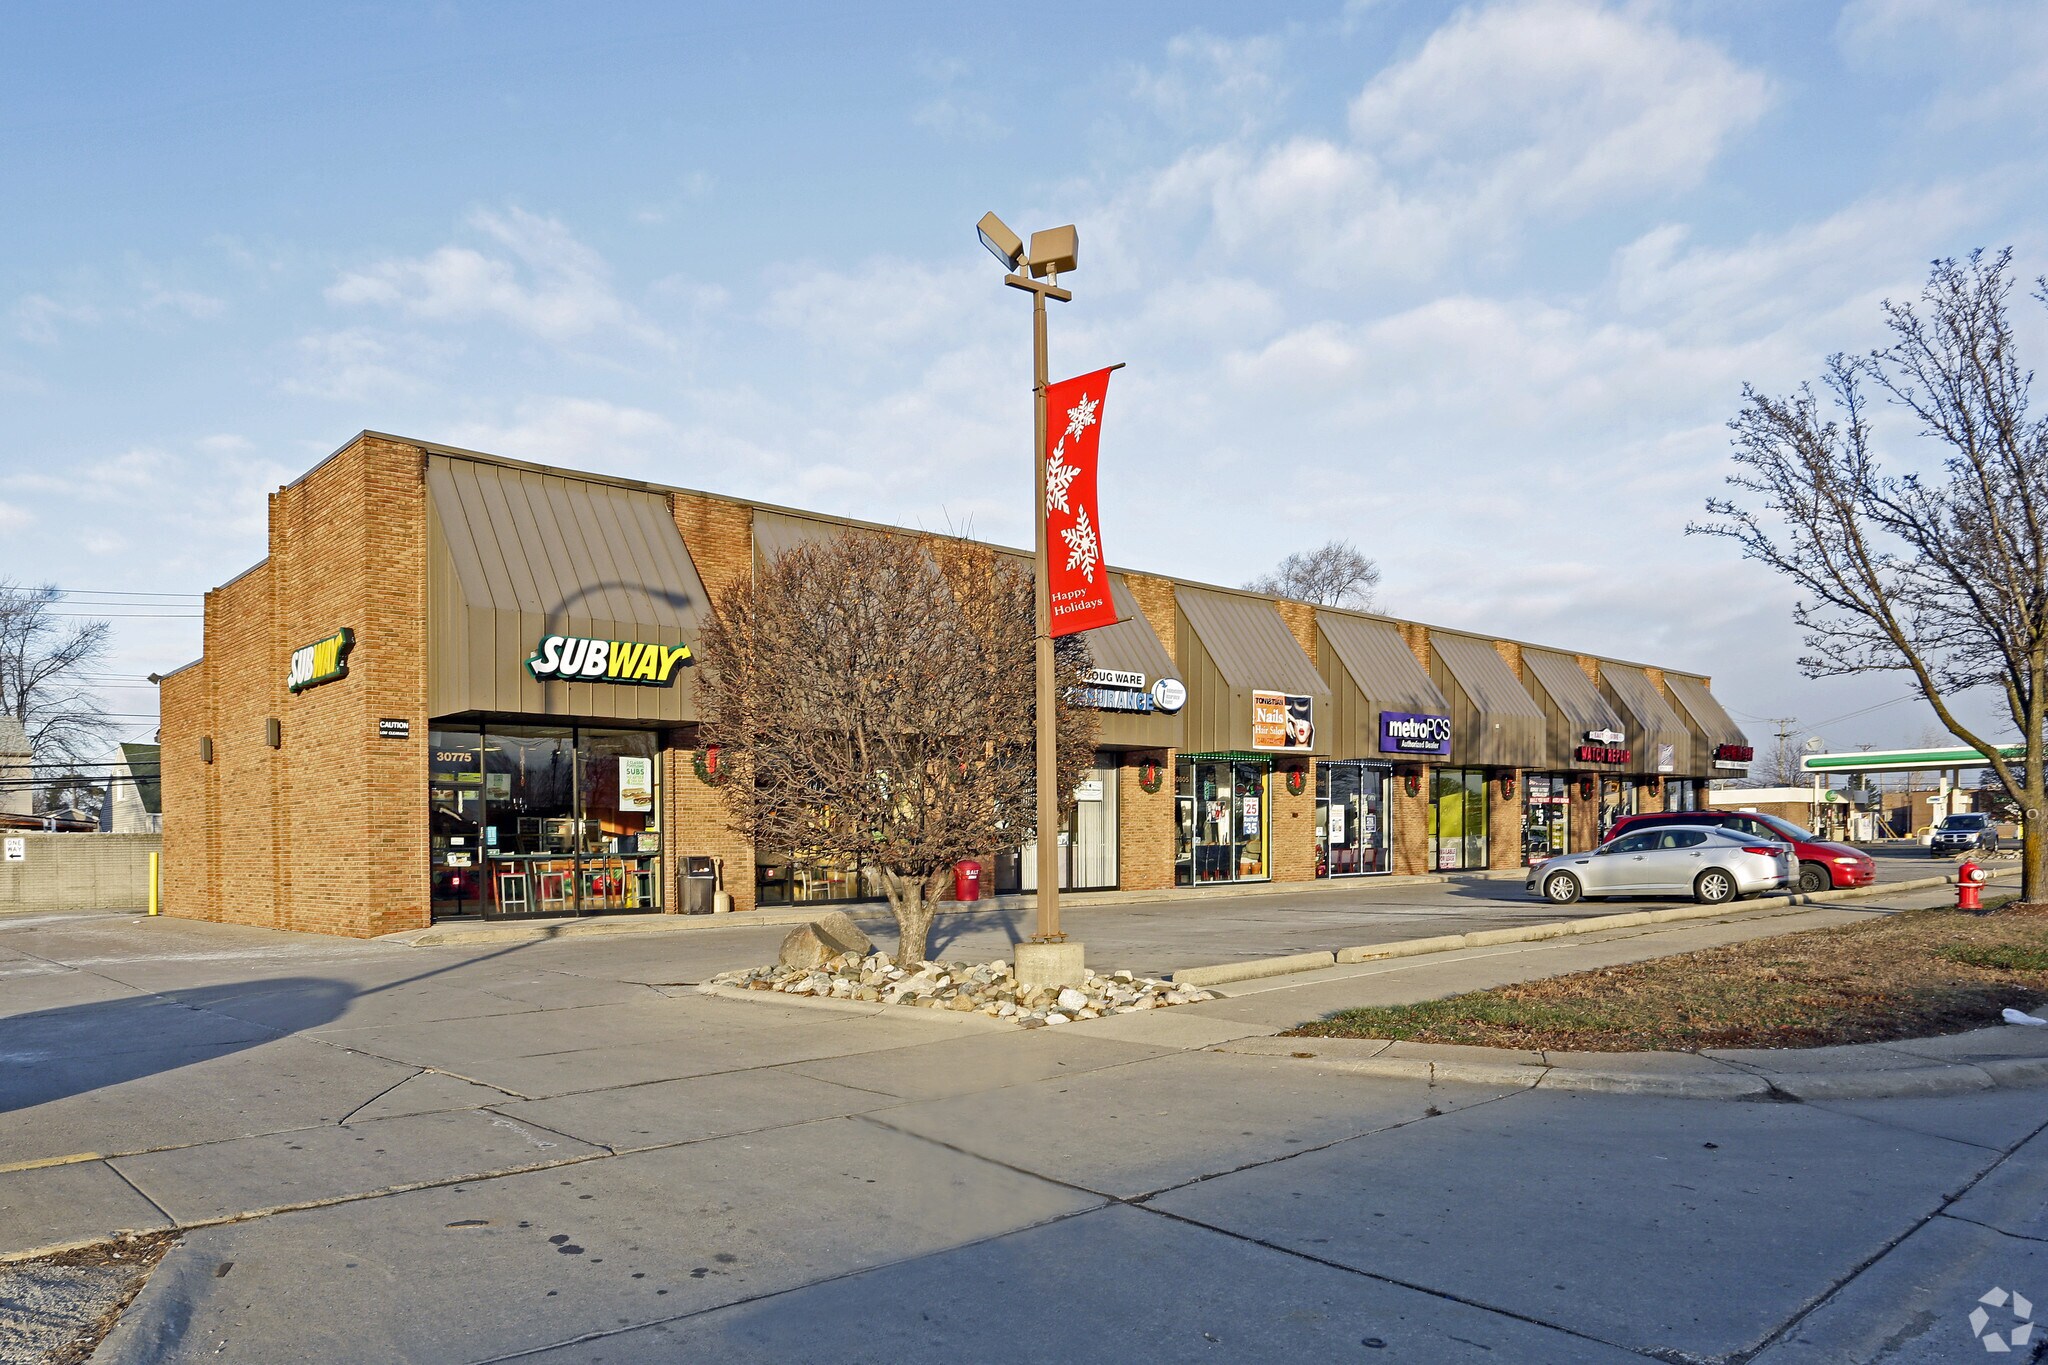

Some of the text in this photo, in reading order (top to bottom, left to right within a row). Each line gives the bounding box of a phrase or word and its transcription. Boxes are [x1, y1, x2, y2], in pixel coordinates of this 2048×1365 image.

[1051, 588, 1087, 603] Happy
[1054, 598, 1103, 616] Holidays
[287, 632, 343, 688] SUBWAY
[530, 636, 692, 681] SUBWAY
[1085, 670, 1143, 685] OUG WARE
[1256, 707, 1284, 724] Nails
[380, 721, 409, 729] CAUTION
[1255, 725, 1285, 736] Hair Salon
[1388, 718, 1451, 741] metroPCS
[1401, 740, 1440, 749] Authorized Dealer
[436, 752, 472, 762] 30775
[1581, 746, 1631, 763] WATCH REPAIR
